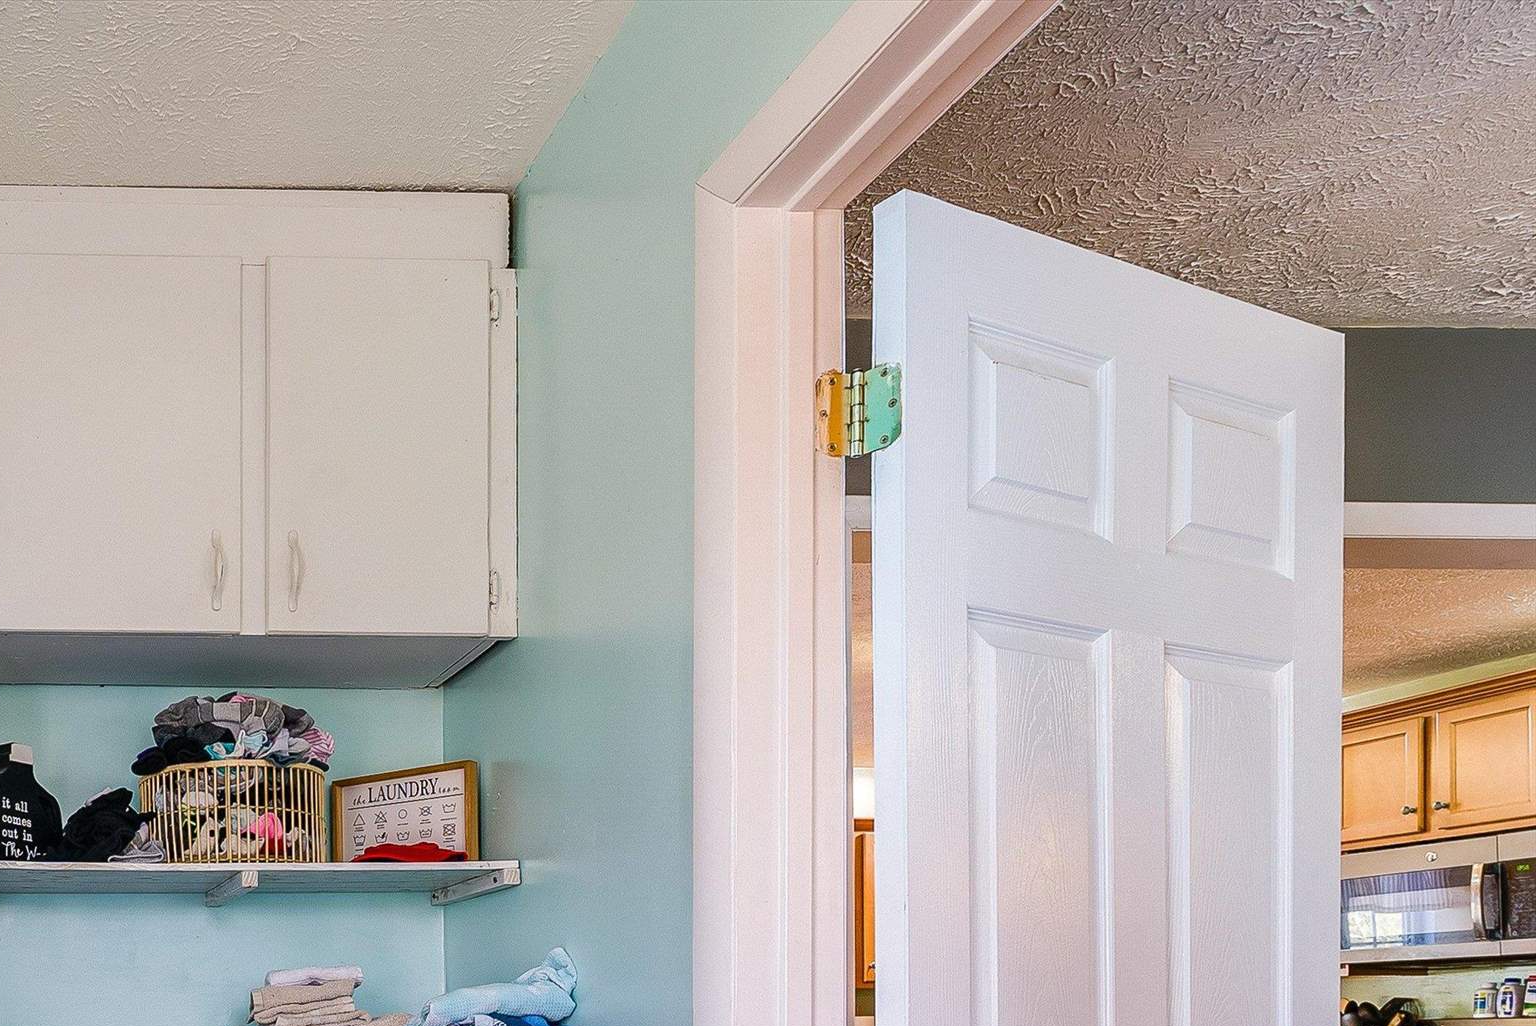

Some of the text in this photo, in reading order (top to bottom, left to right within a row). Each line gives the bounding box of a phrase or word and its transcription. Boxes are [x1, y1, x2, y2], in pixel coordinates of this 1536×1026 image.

[353, 794, 366, 806] the
[368, 778, 439, 803] LAUNDRY
[1, 796, 28, 813] it all
[1, 814, 32, 828] comes
[1, 828, 33, 842] out in
[1, 841, 24, 858] The
